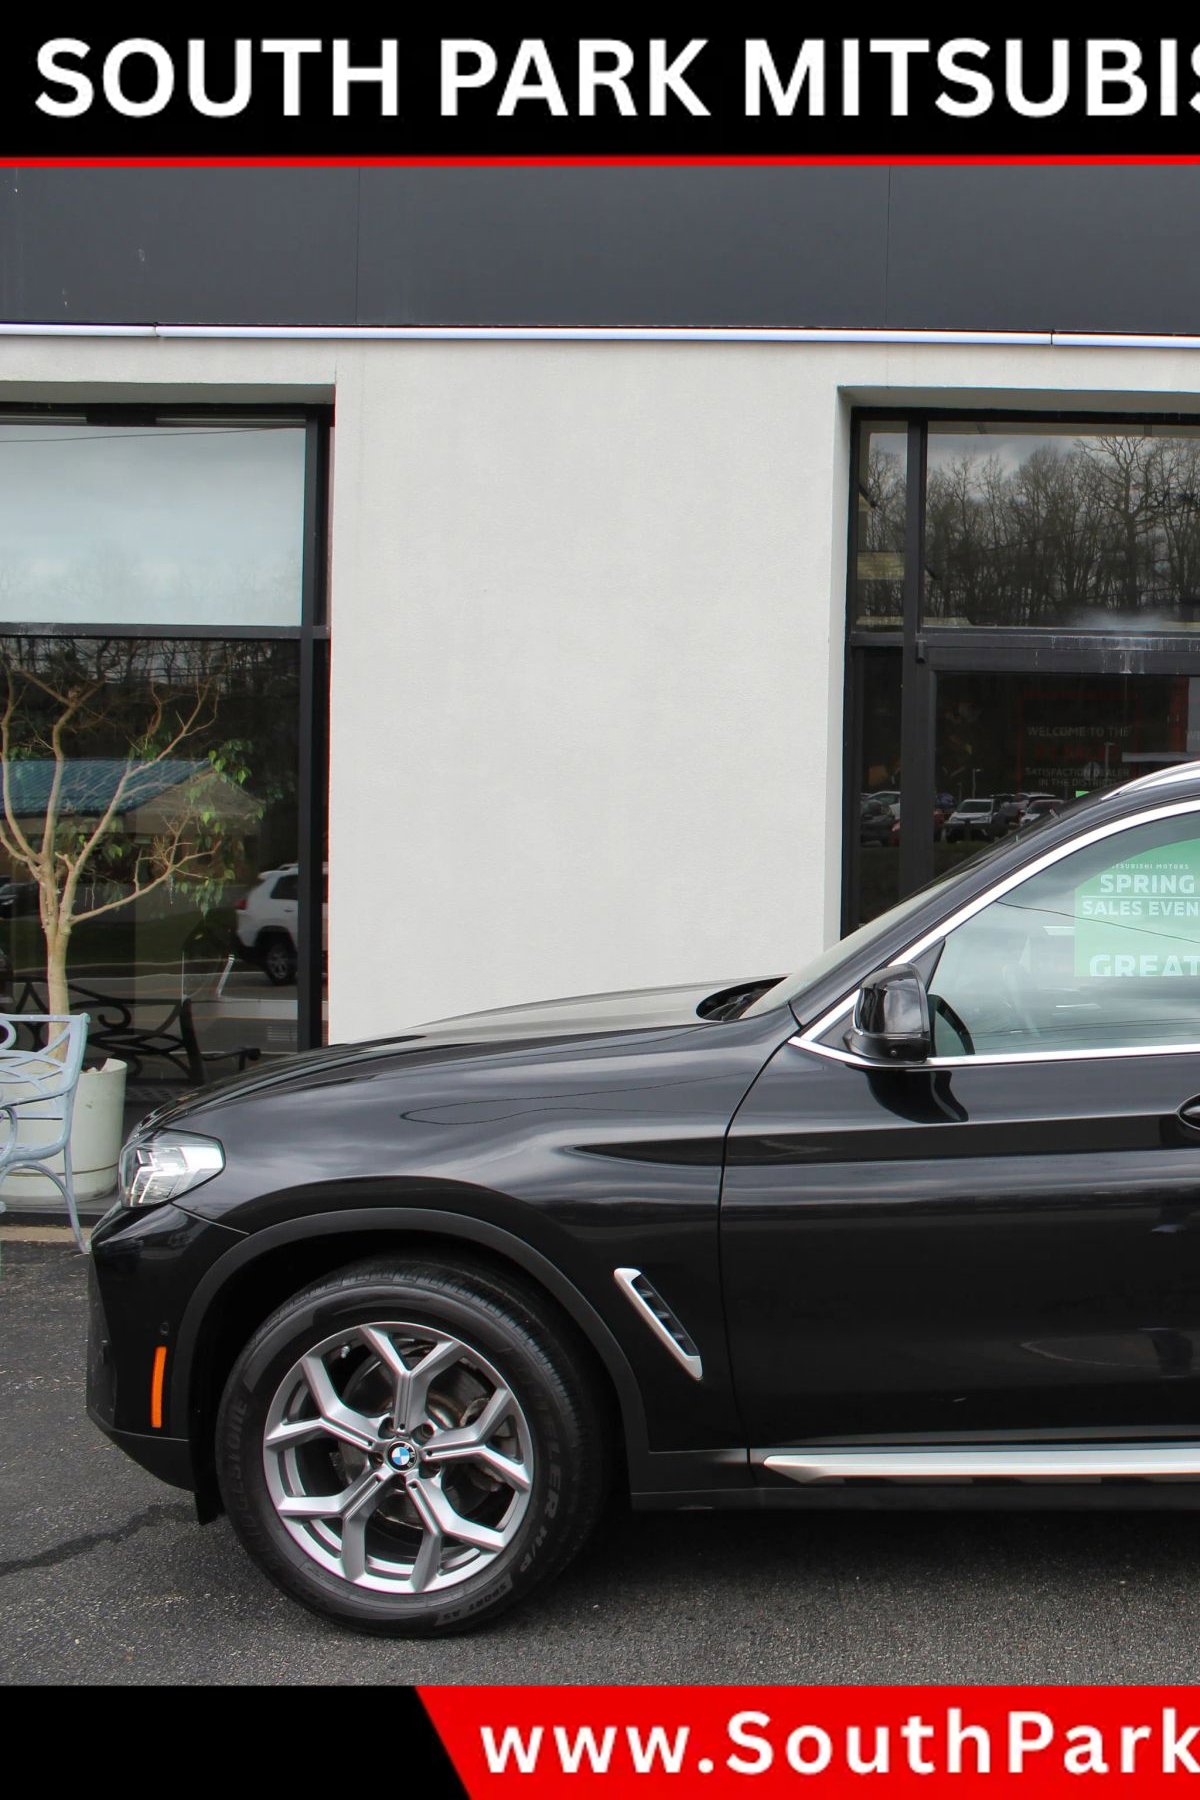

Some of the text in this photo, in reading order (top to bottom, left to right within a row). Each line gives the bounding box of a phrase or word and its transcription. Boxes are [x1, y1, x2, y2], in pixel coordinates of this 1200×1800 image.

[1027, 726, 1130, 738] WELCOME TO THE
[1099, 873, 1196, 894] SPRING
[1081, 900, 1142, 917] SALES
